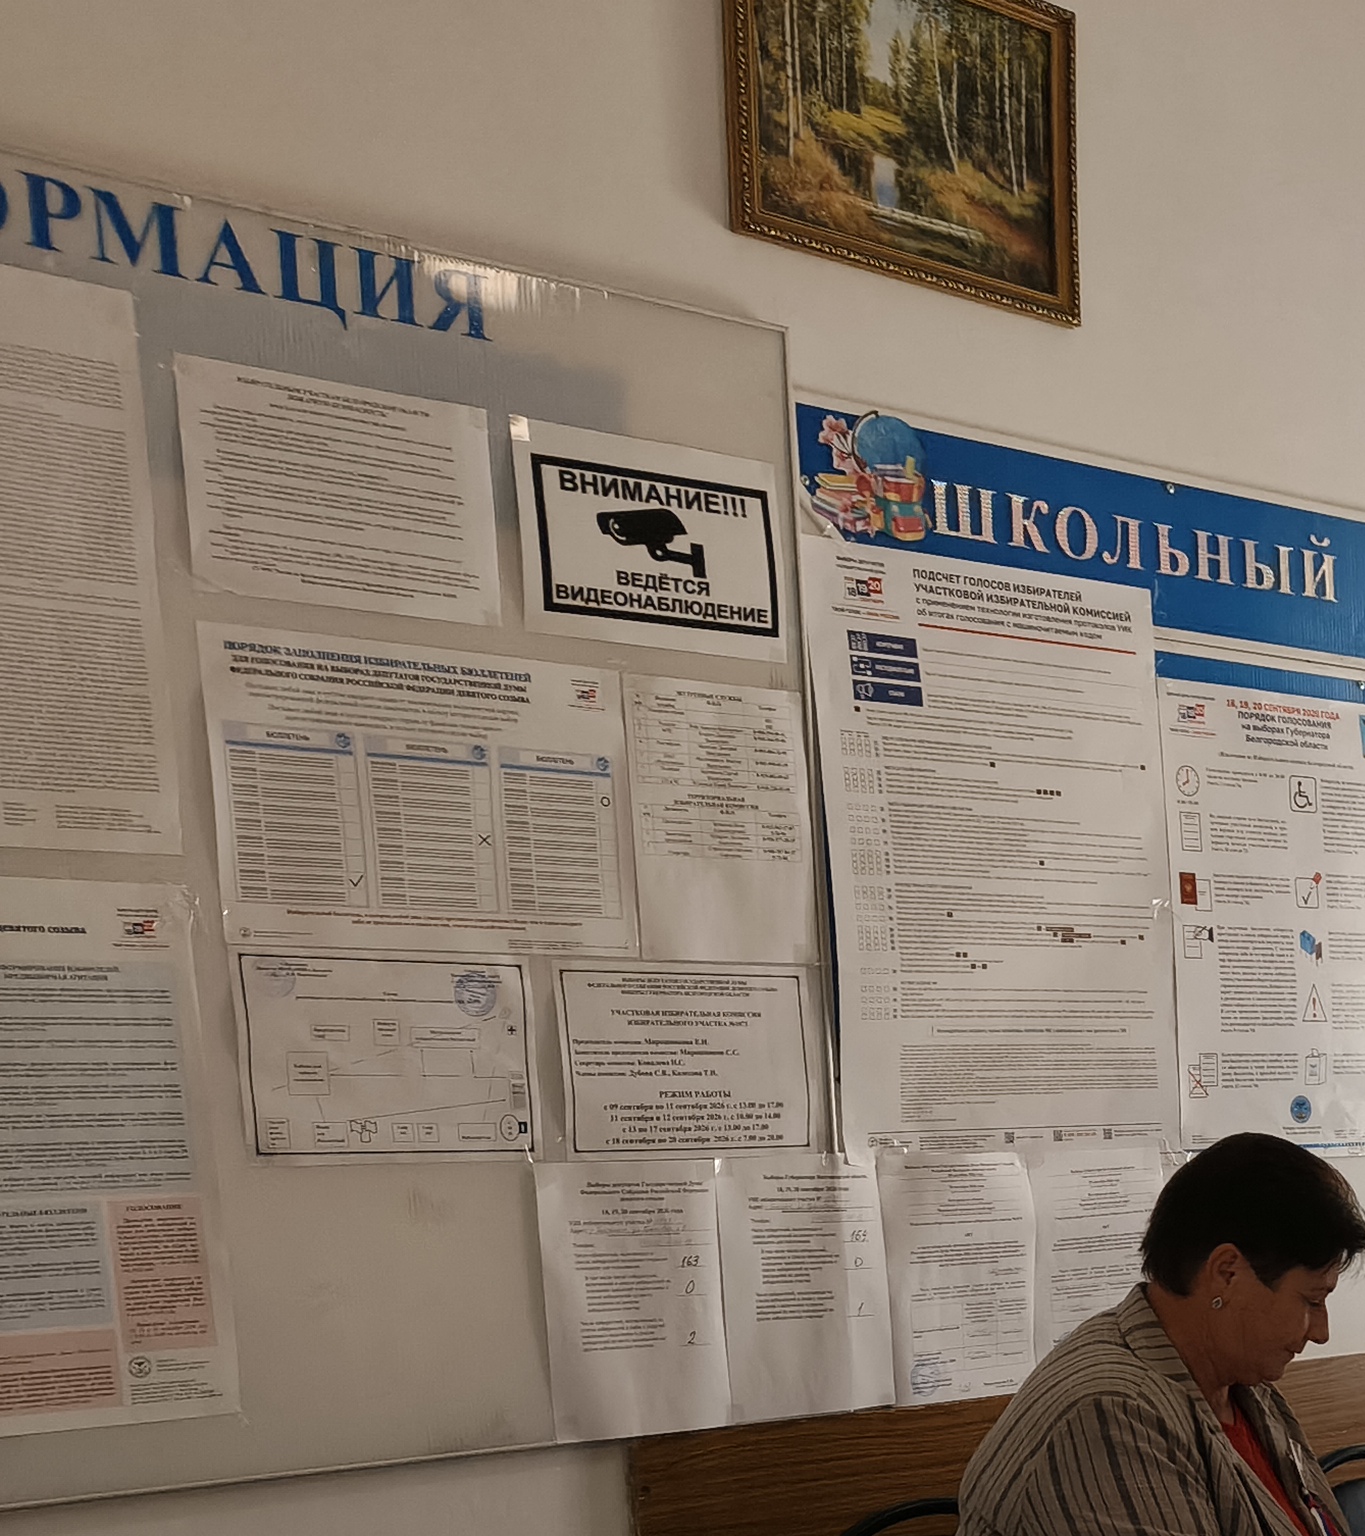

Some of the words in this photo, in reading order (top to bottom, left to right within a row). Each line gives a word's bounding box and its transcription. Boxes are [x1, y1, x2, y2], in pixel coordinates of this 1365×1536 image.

[0, 168, 494, 343] РМАЦИЯ
[558, 469, 748, 518] ВНИМАНИЕ!!!
[930, 478, 1338, 603] ШКОЛЬНЫЙ
[616, 569, 711, 597] ВЕДЁТСЯ
[912, 568, 961, 584] ПОДСЧЕТ
[963, 576, 1011, 592] ГОЛОСОВ
[1012, 583, 1082, 602] ИЗБИРАТЕЛЕЙ
[555, 583, 769, 624] ВИДЕОНАБЛЮДЕНИЕ
[913, 582, 984, 600] УЧАСТКОВОЙ
[986, 593, 1071, 614] ИЗБИРАТЕЛЬНОЙ
[1072, 606, 1132, 622] КОМИССИЕЙ
[222, 640, 282, 655] ПОРЯДОК
[364, 655, 459, 676] ИЗБИРАТЕЛЬНЫХ
[460, 666, 532, 683] БЮЛЛЕТЕНЕЙ
[1237, 711, 1276, 724] ПОРЯДОК
[1277, 715, 1332, 729] ГОЛОСОВАНИЯ
[1263, 703, 1302, 715] СЕНТЯБРЯ
[1320, 710, 1340, 721] ГОДА
[1252, 723, 1285, 734] выборах
[1285, 727, 1331, 740] Губернатора
[1245, 734, 1299, 748] Белгородской
[659, 1090, 693, 1098] РЕЖИМ
[694, 1090, 732, 1098] РАБОТЫ
[680, 1254, 701, 1268] 163
[854, 1256, 863, 1268] 0
[684, 1280, 696, 1294] 0
[686, 1330, 698, 1345] 2
